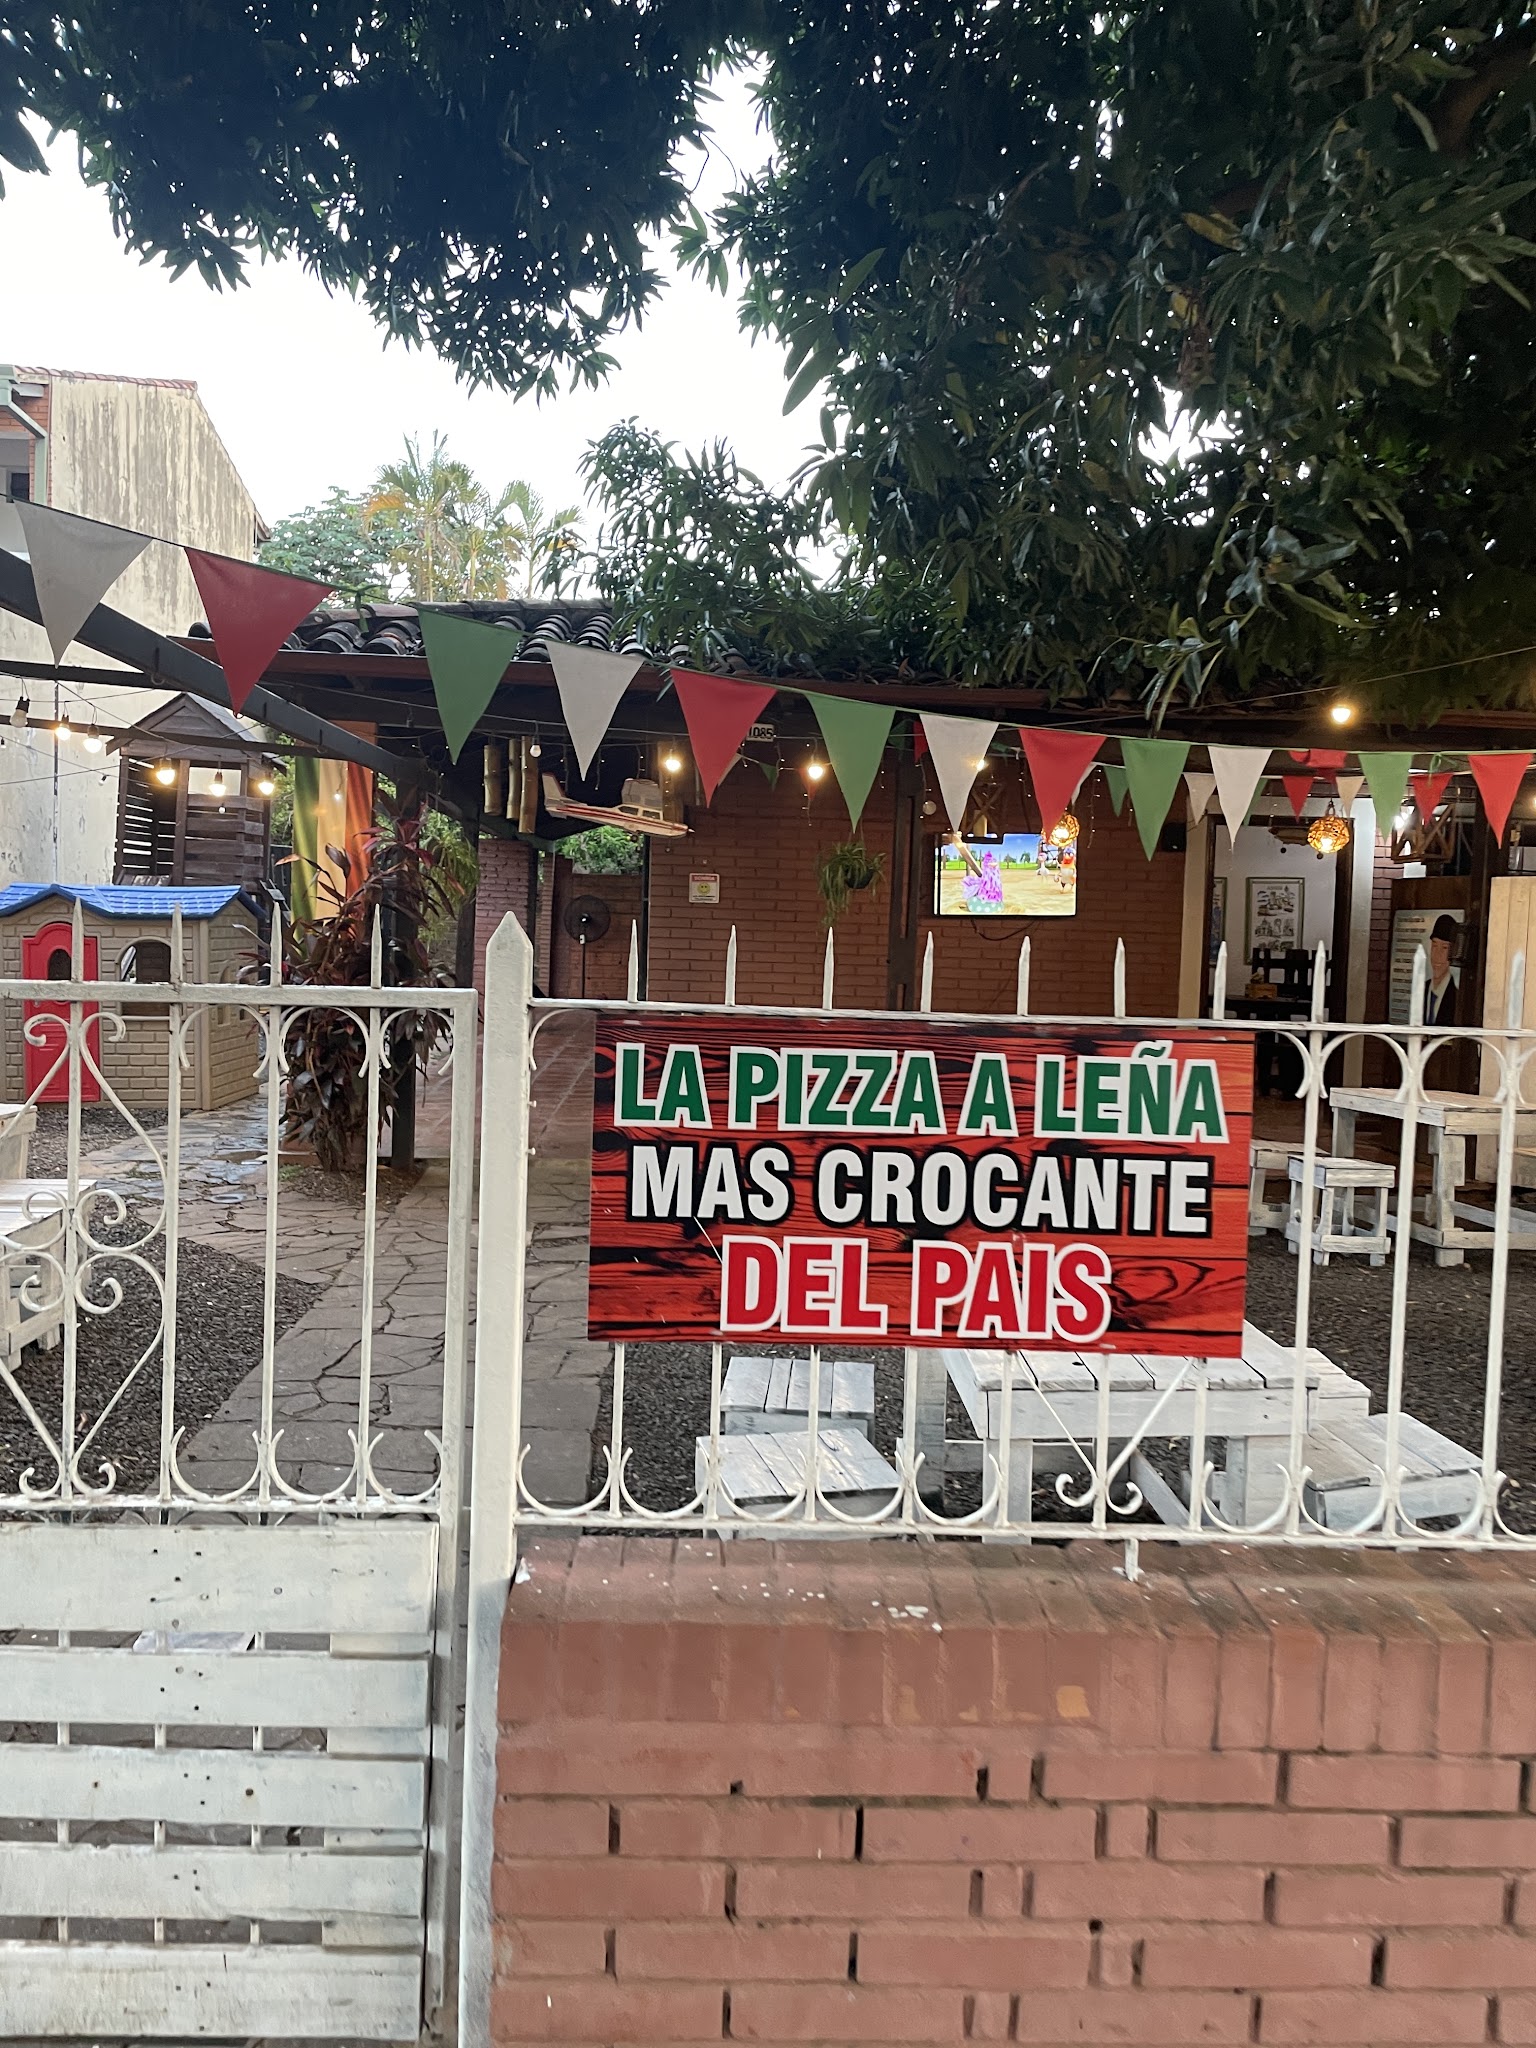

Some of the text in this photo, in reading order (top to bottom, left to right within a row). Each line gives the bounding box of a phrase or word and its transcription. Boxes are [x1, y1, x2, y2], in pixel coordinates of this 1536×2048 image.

[748, 726, 774, 737] 1085
[615, 1041, 1228, 1142] LA PIZZA A LEÑA
[630, 1144, 1210, 1233] MAS CROCANTE
[721, 1236, 1111, 1342] DEL PAIS
